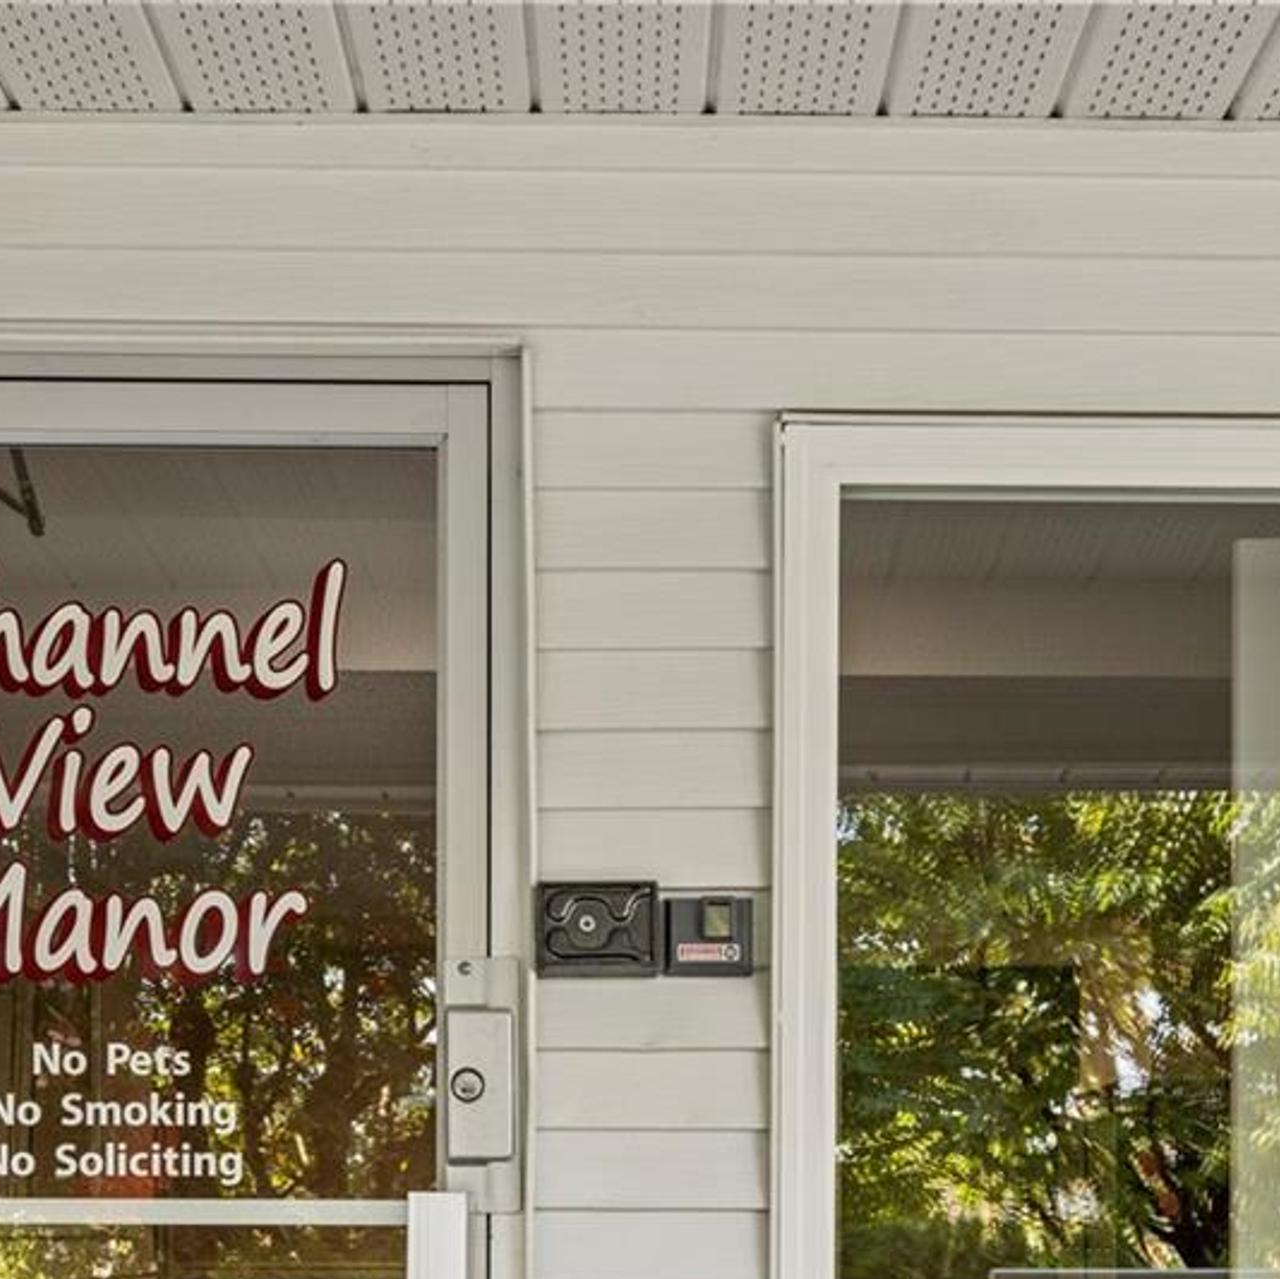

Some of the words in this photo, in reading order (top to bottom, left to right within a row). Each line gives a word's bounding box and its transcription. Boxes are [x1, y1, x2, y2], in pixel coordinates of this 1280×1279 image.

[32, 1043, 87, 1076] No
[107, 1042, 191, 1076] Pets
[61, 1092, 237, 1134] Smoking
[55, 1143, 243, 1186] Soliciting
